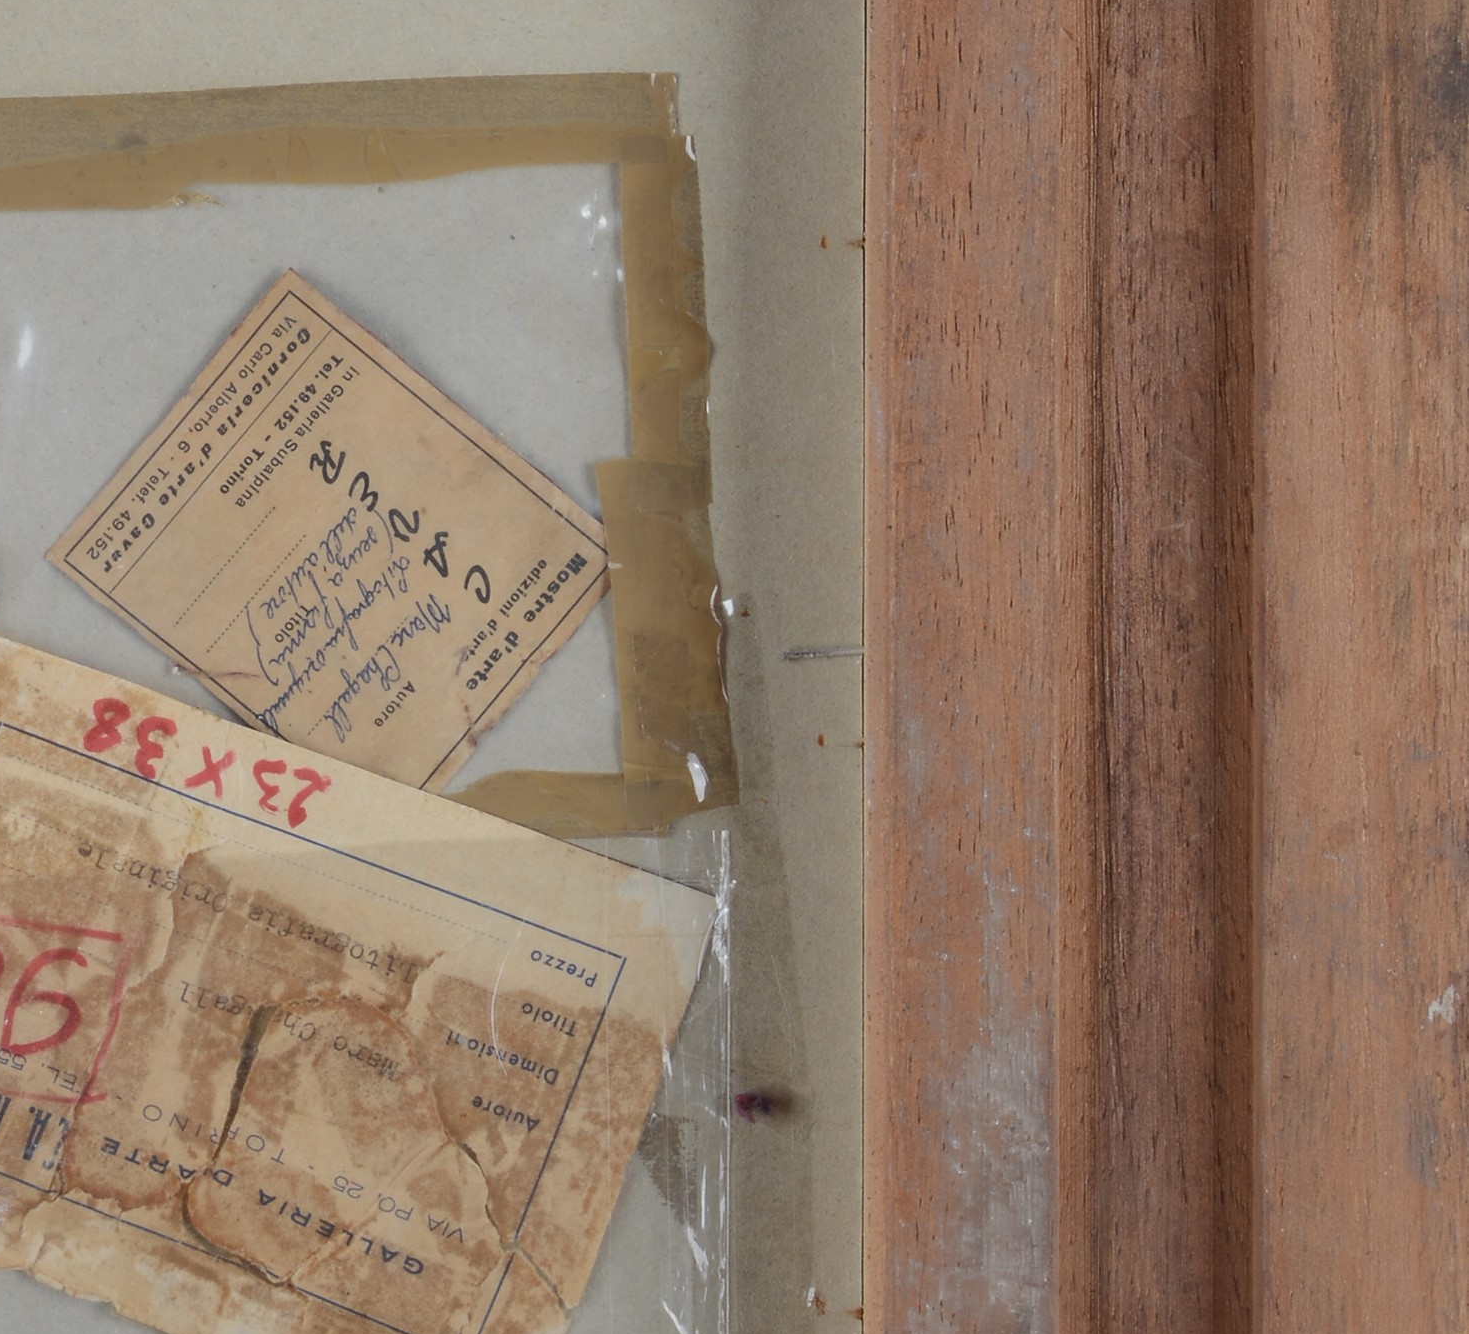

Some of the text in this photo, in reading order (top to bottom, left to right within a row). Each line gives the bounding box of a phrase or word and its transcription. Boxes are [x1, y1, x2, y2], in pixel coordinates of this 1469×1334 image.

[270, 313, 297, 342] Via
[214, 325, 314, 440] Corniceria
[236, 340, 274, 382] Carlo
[313, 351, 344, 384] Tel.
[186, 379, 240, 439] Alberto,
[272, 381, 319, 433] 49.152
[175, 438, 192, 454] 6
[232, 364, 360, 511] in Galleria Subalpina
[130, 463, 170, 508] Telef.
[155, 440, 216, 509] d'arte
[217, 444, 266, 498] Torino
[84, 506, 134, 562] 49.152
[497, 557, 551, 618] edizioni
[463, 551, 588, 695] Mostre d'arte
[320, 587, 458, 744] Marc Chagall
[371, 679, 417, 730] Autore
[80, 693, 176, 779] 38
[253, 757, 331, 828] 23
[526, 947, 598, 988] Prezzo
[517, 1000, 579, 1037] Titolo
[467, 1093, 541, 1134] Autore
[330, 1173, 365, 1200] 25
[253, 1187, 426, 1277] GALLERIA
[423, 1212, 467, 1243] VIA
